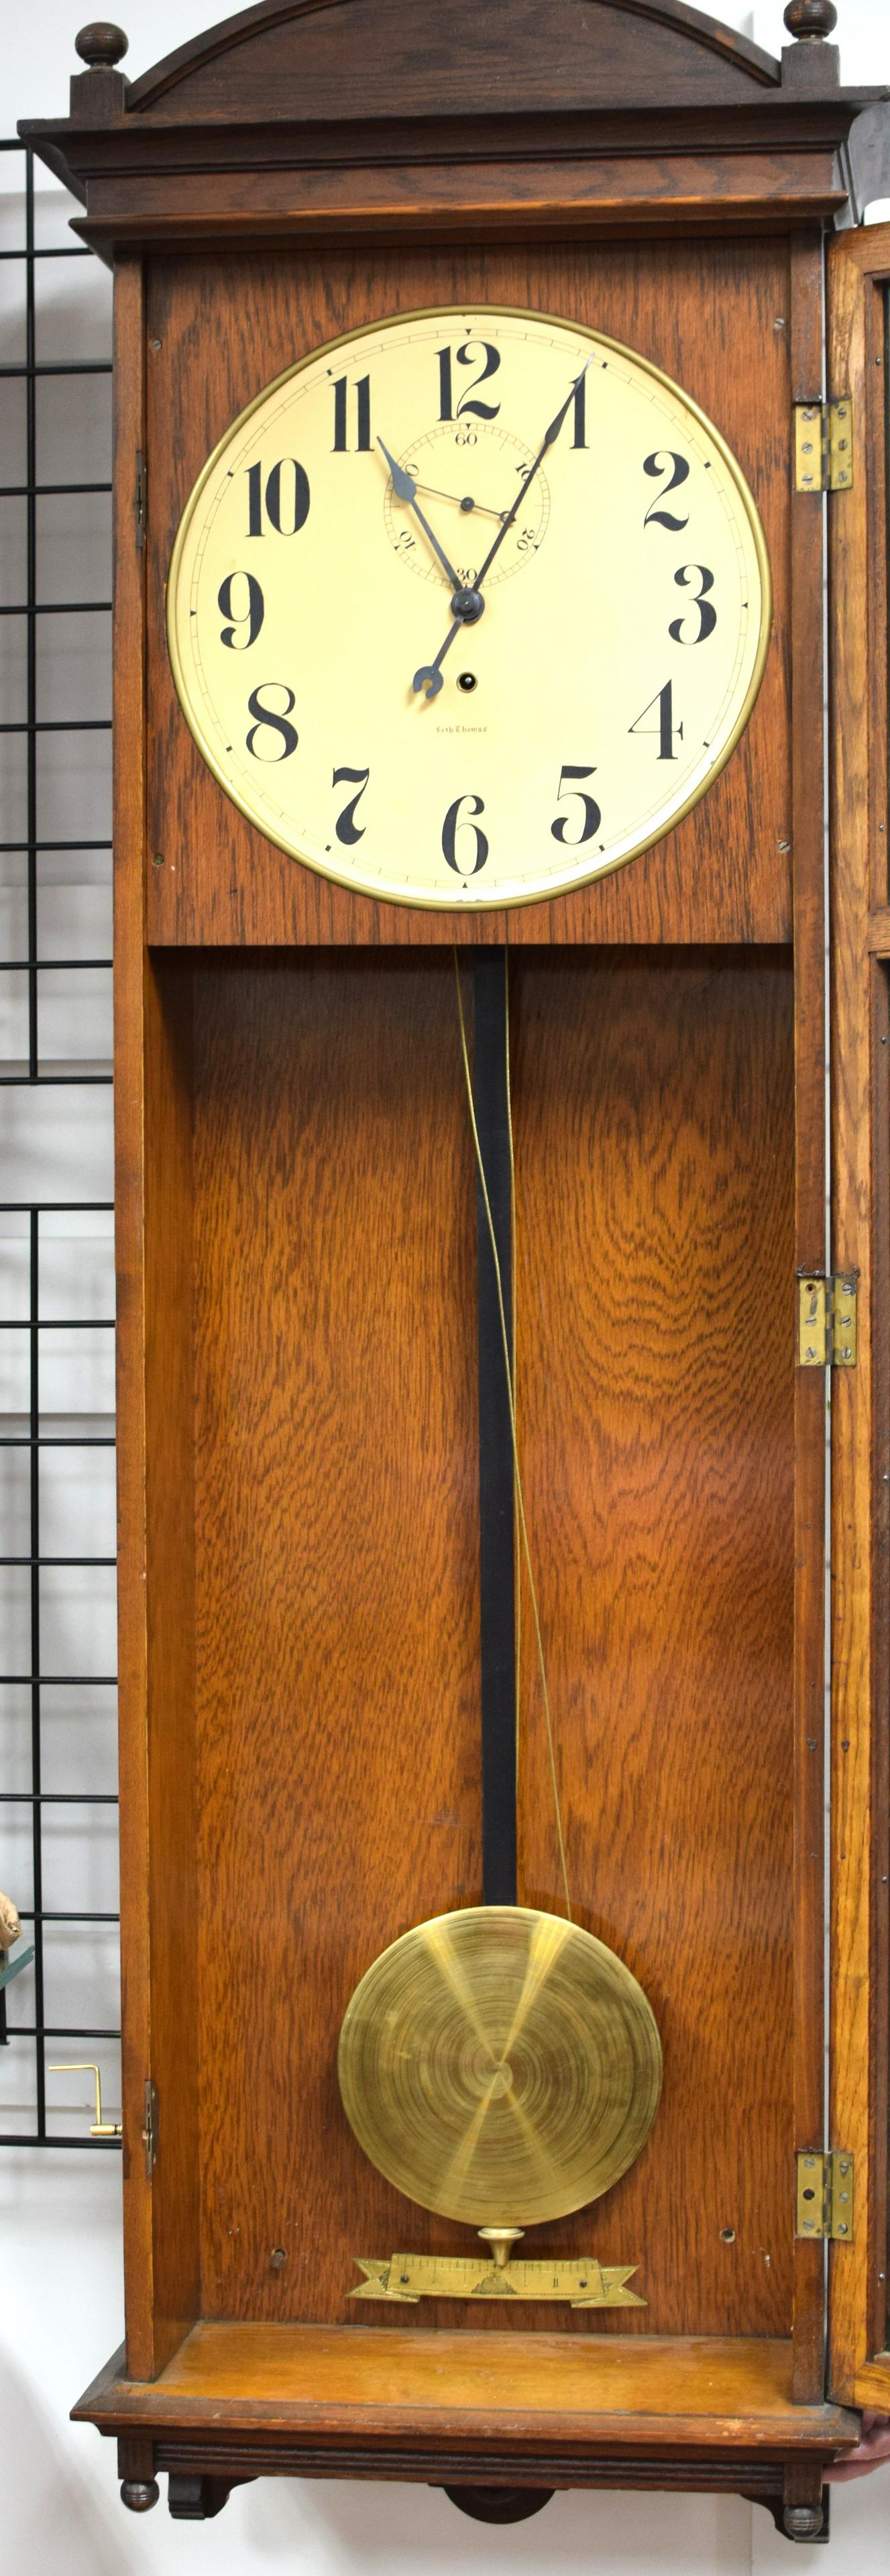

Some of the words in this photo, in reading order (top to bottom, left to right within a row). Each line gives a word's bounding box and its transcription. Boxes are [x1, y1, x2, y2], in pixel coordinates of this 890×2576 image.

[327, 374, 374, 453] 11
[434, 341, 501, 422] 12
[569, 374, 590, 449] 1
[455, 433, 478, 445] 60
[243, 458, 311, 537] 10
[643, 450, 689, 532] 2
[457, 568, 477, 581] 30
[516, 529, 535, 551] 20
[217, 571, 265, 650] 9
[668, 564, 717, 645] 3
[245, 682, 299, 762] 8
[627, 679, 684, 760] 4
[331, 767, 370, 845] 7
[441, 794, 489, 875] 6
[550, 765, 602, 845] 5
